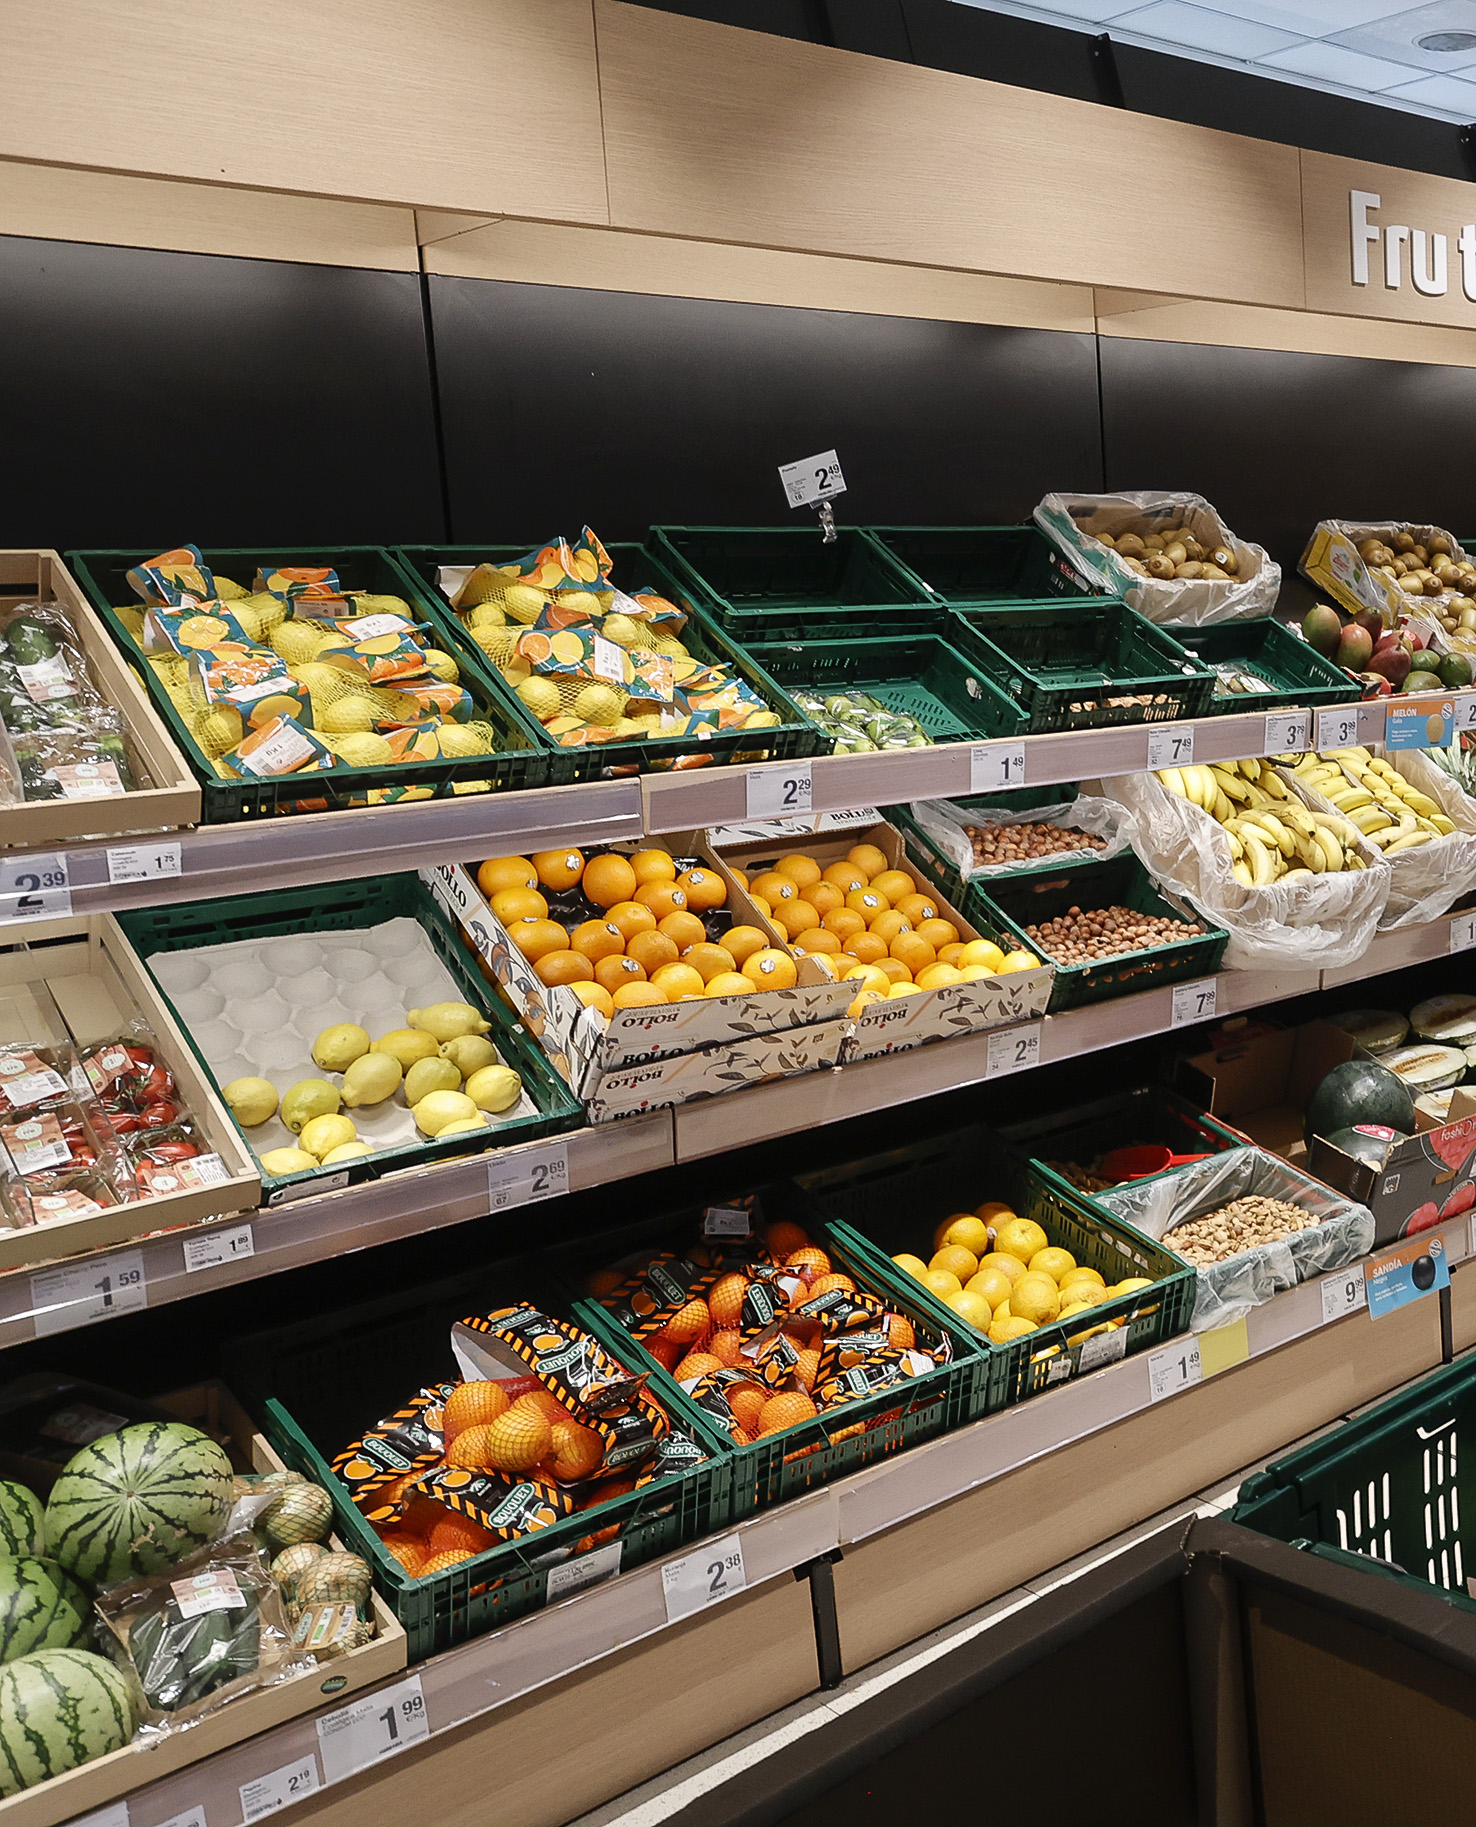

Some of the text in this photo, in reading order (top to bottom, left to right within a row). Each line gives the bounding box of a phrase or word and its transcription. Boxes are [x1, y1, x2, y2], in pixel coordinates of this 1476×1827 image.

[814, 463, 840, 490] 2 49
[1392, 706, 1417, 717] MELÓN
[1468, 704, 1476, 722] 2
[1286, 726, 1297, 745] 3
[1338, 722, 1348, 741] 3
[1172, 738, 1182, 759] 7
[1001, 756, 1024, 779] 1 49
[783, 778, 811, 805] 2 29
[830, 808, 874, 821] BOLL
[154, 855, 175, 869] 1 75
[14, 871, 66, 908] 2 39
[1468, 922, 1474, 940] 1
[1196, 993, 1206, 1014] 7
[621, 1012, 680, 1028] BOLLO
[860, 1008, 909, 1028] BOLLO
[1015, 1037, 1038, 1062] 2 45
[606, 1069, 664, 1090] BOLLO
[531, 1160, 565, 1193] 2 69
[228, 1239, 236, 1251] 1
[1372, 1258, 1403, 1278] SANDÍA
[94, 1276, 113, 1307] 1
[119, 1269, 141, 1287] 59
[1345, 1281, 1356, 1303] 9
[1178, 1351, 1200, 1379] 1 49
[367, 1439, 410, 1469] BOUQUET
[494, 1485, 531, 1524] BOUQUET
[707, 1553, 741, 1593] 2 38
[379, 1695, 423, 1740] 1 99
[288, 1776, 299, 1792] 2
